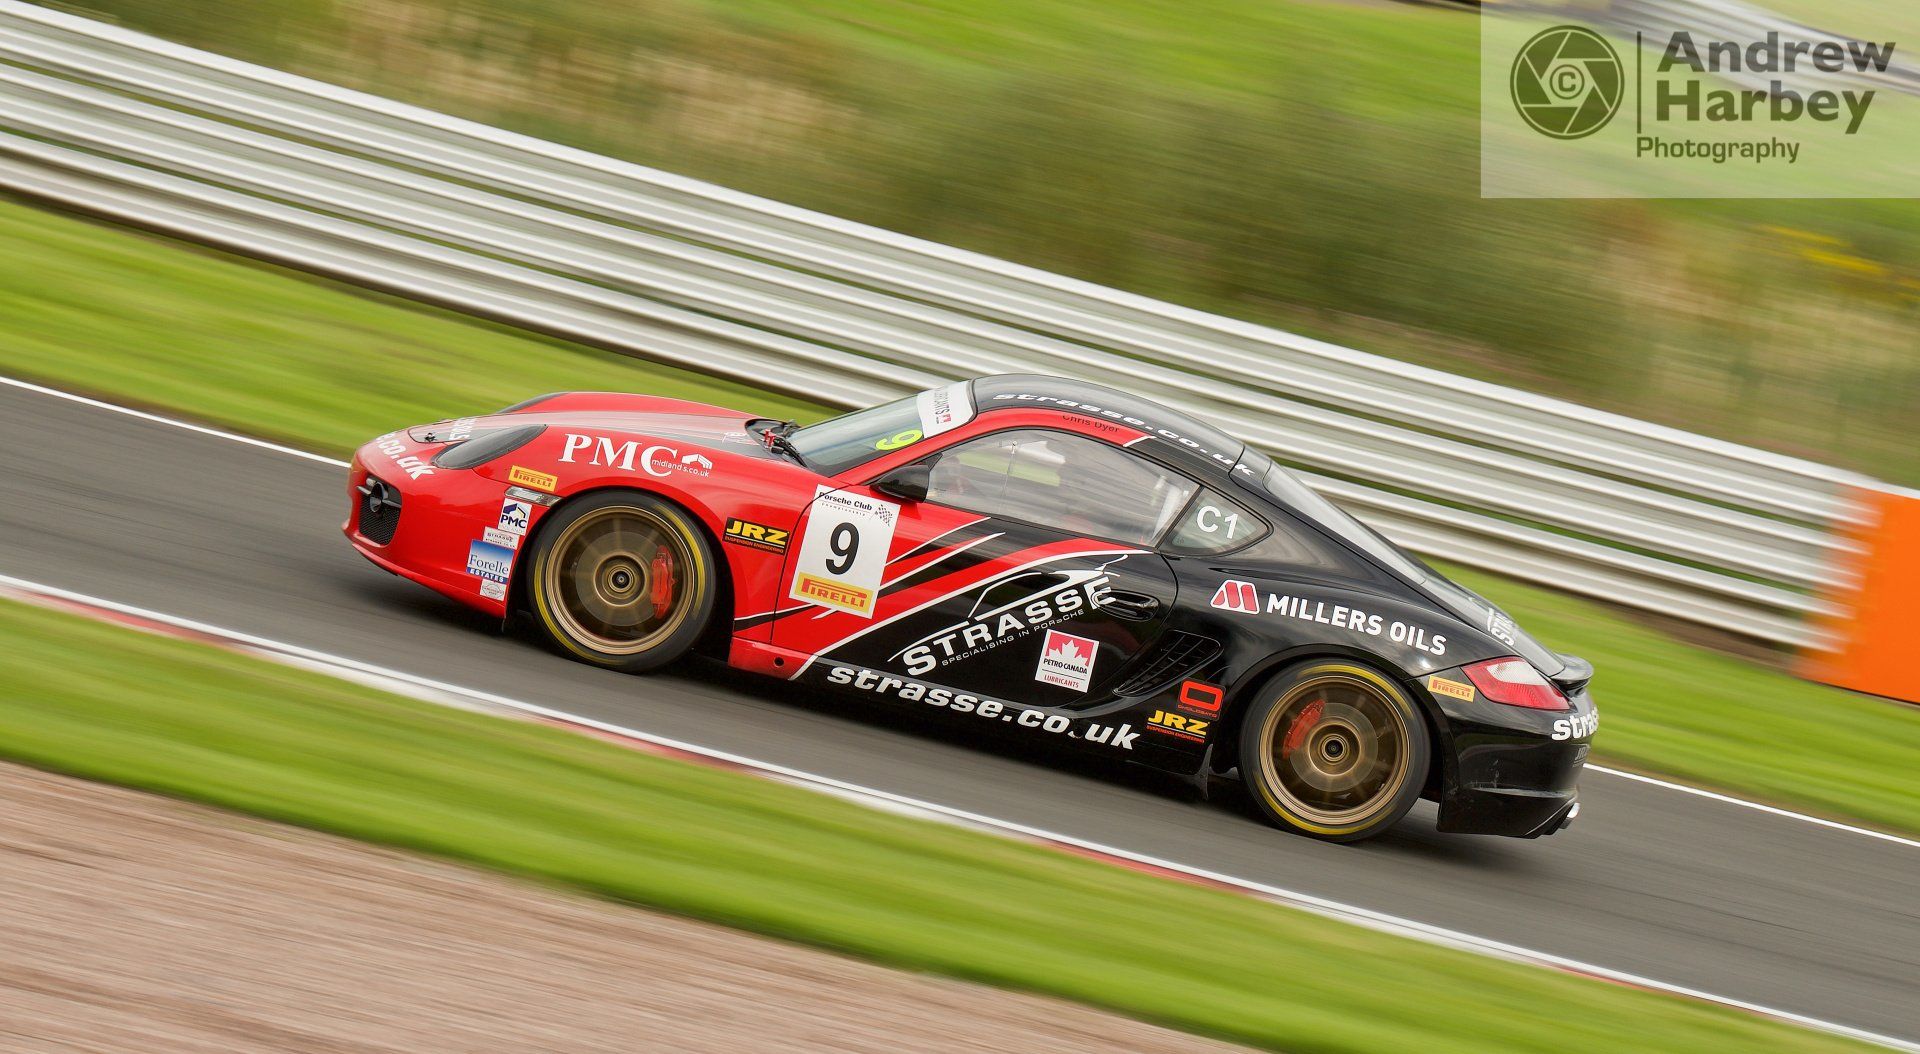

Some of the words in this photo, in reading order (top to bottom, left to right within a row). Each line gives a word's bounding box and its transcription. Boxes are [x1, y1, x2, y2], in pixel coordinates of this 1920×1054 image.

[993, 394, 1255, 476] strasse.co.uk
[1062, 415, 1091, 426] Chris
[1094, 421, 1120, 432] Dyer
[558, 433, 678, 477] PMC
[514, 469, 553, 488] PIRELLI
[818, 492, 852, 506] Porsche
[853, 500, 873, 511] Club
[500, 514, 528, 529] PMC
[727, 520, 788, 546] JRZ
[1197, 505, 1239, 539] C1
[825, 522, 860, 576] 9
[469, 553, 509, 575] Forelle
[469, 568, 505, 583] ESTATES
[801, 578, 868, 608] PIRELLI
[903, 576, 1117, 676] STRASSE
[1266, 593, 1383, 636] MILLERS
[1389, 621, 1447, 656] OILS
[941, 635, 1015, 667] SPECIALISING
[1018, 629, 1030, 639] IN
[1044, 674, 1080, 689] LUBRICANTS
[1432, 679, 1472, 698] PIRELLI
[826, 666, 1141, 750] strasse.co.uk
[1147, 709, 1207, 736] JRZ
